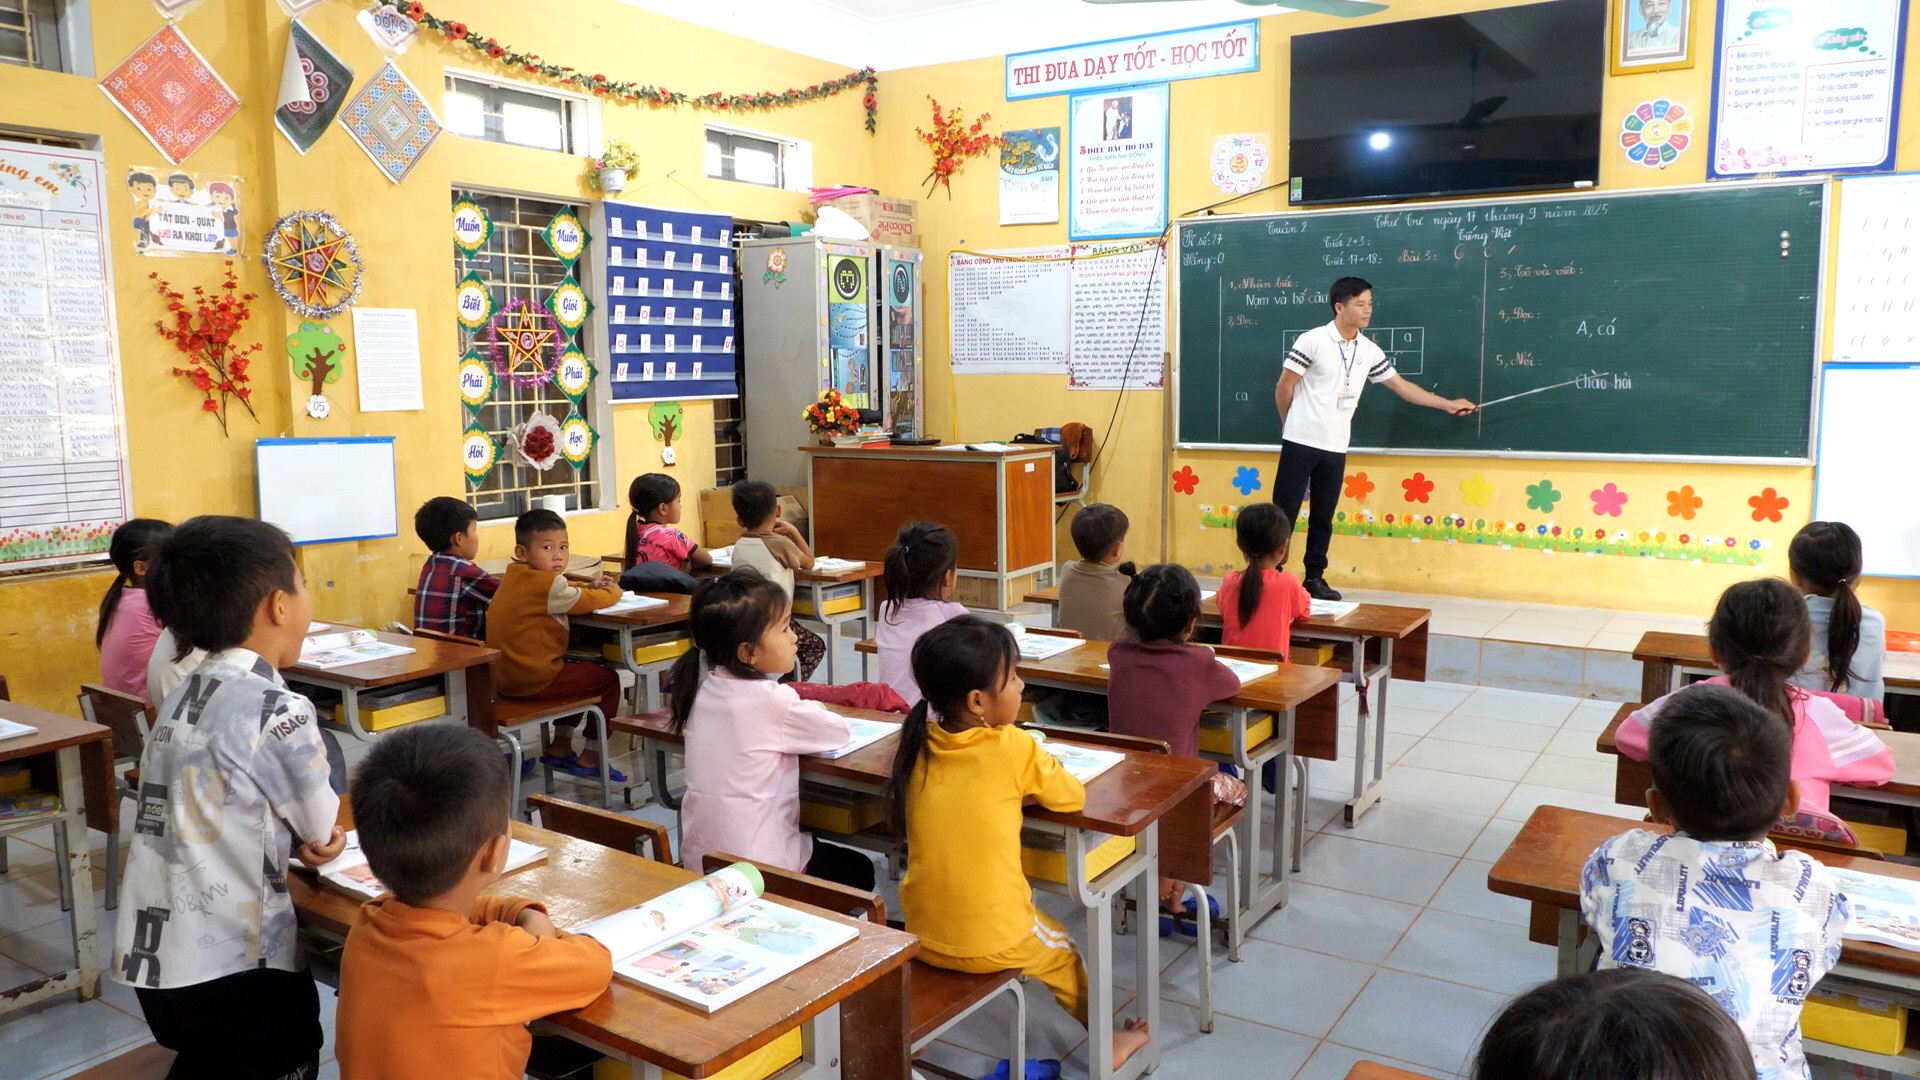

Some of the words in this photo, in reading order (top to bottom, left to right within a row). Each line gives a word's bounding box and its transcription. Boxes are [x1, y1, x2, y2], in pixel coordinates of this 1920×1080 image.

[1013, 66, 1040, 86] THI
[1045, 61, 1079, 81] ĐUA
[1084, 55, 1119, 80] DẠY
[1124, 42, 1156, 71] TỐT
[1170, 42, 1207, 68] HỌC
[1212, 28, 1247, 60] TỐT
[1080, 145, 1087, 156] 5
[34, 175, 59, 195] em
[456, 217, 480, 232] Muốn
[1433, 211, 1462, 231] ngày
[1485, 207, 1525, 226] tháng
[1528, 207, 1537, 220] 9
[1543, 205, 1576, 218] năm
[158, 229, 171, 239] KHI
[173, 230, 184, 240] RA
[556, 228, 578, 243] Muốn
[1456, 225, 1489, 247] Tiếng
[1536, 263, 1551, 277] và
[462, 294, 481, 311] Biết
[1274, 290, 1288, 305] và
[1597, 317, 1618, 336] cá
[564, 365, 583, 380] Phải
[461, 373, 483, 388] Phải
[1614, 372, 1632, 390] hỏi
[313, 400, 325, 412] 05
[568, 431, 583, 447] Học
[468, 444, 484, 459] Hỏi
